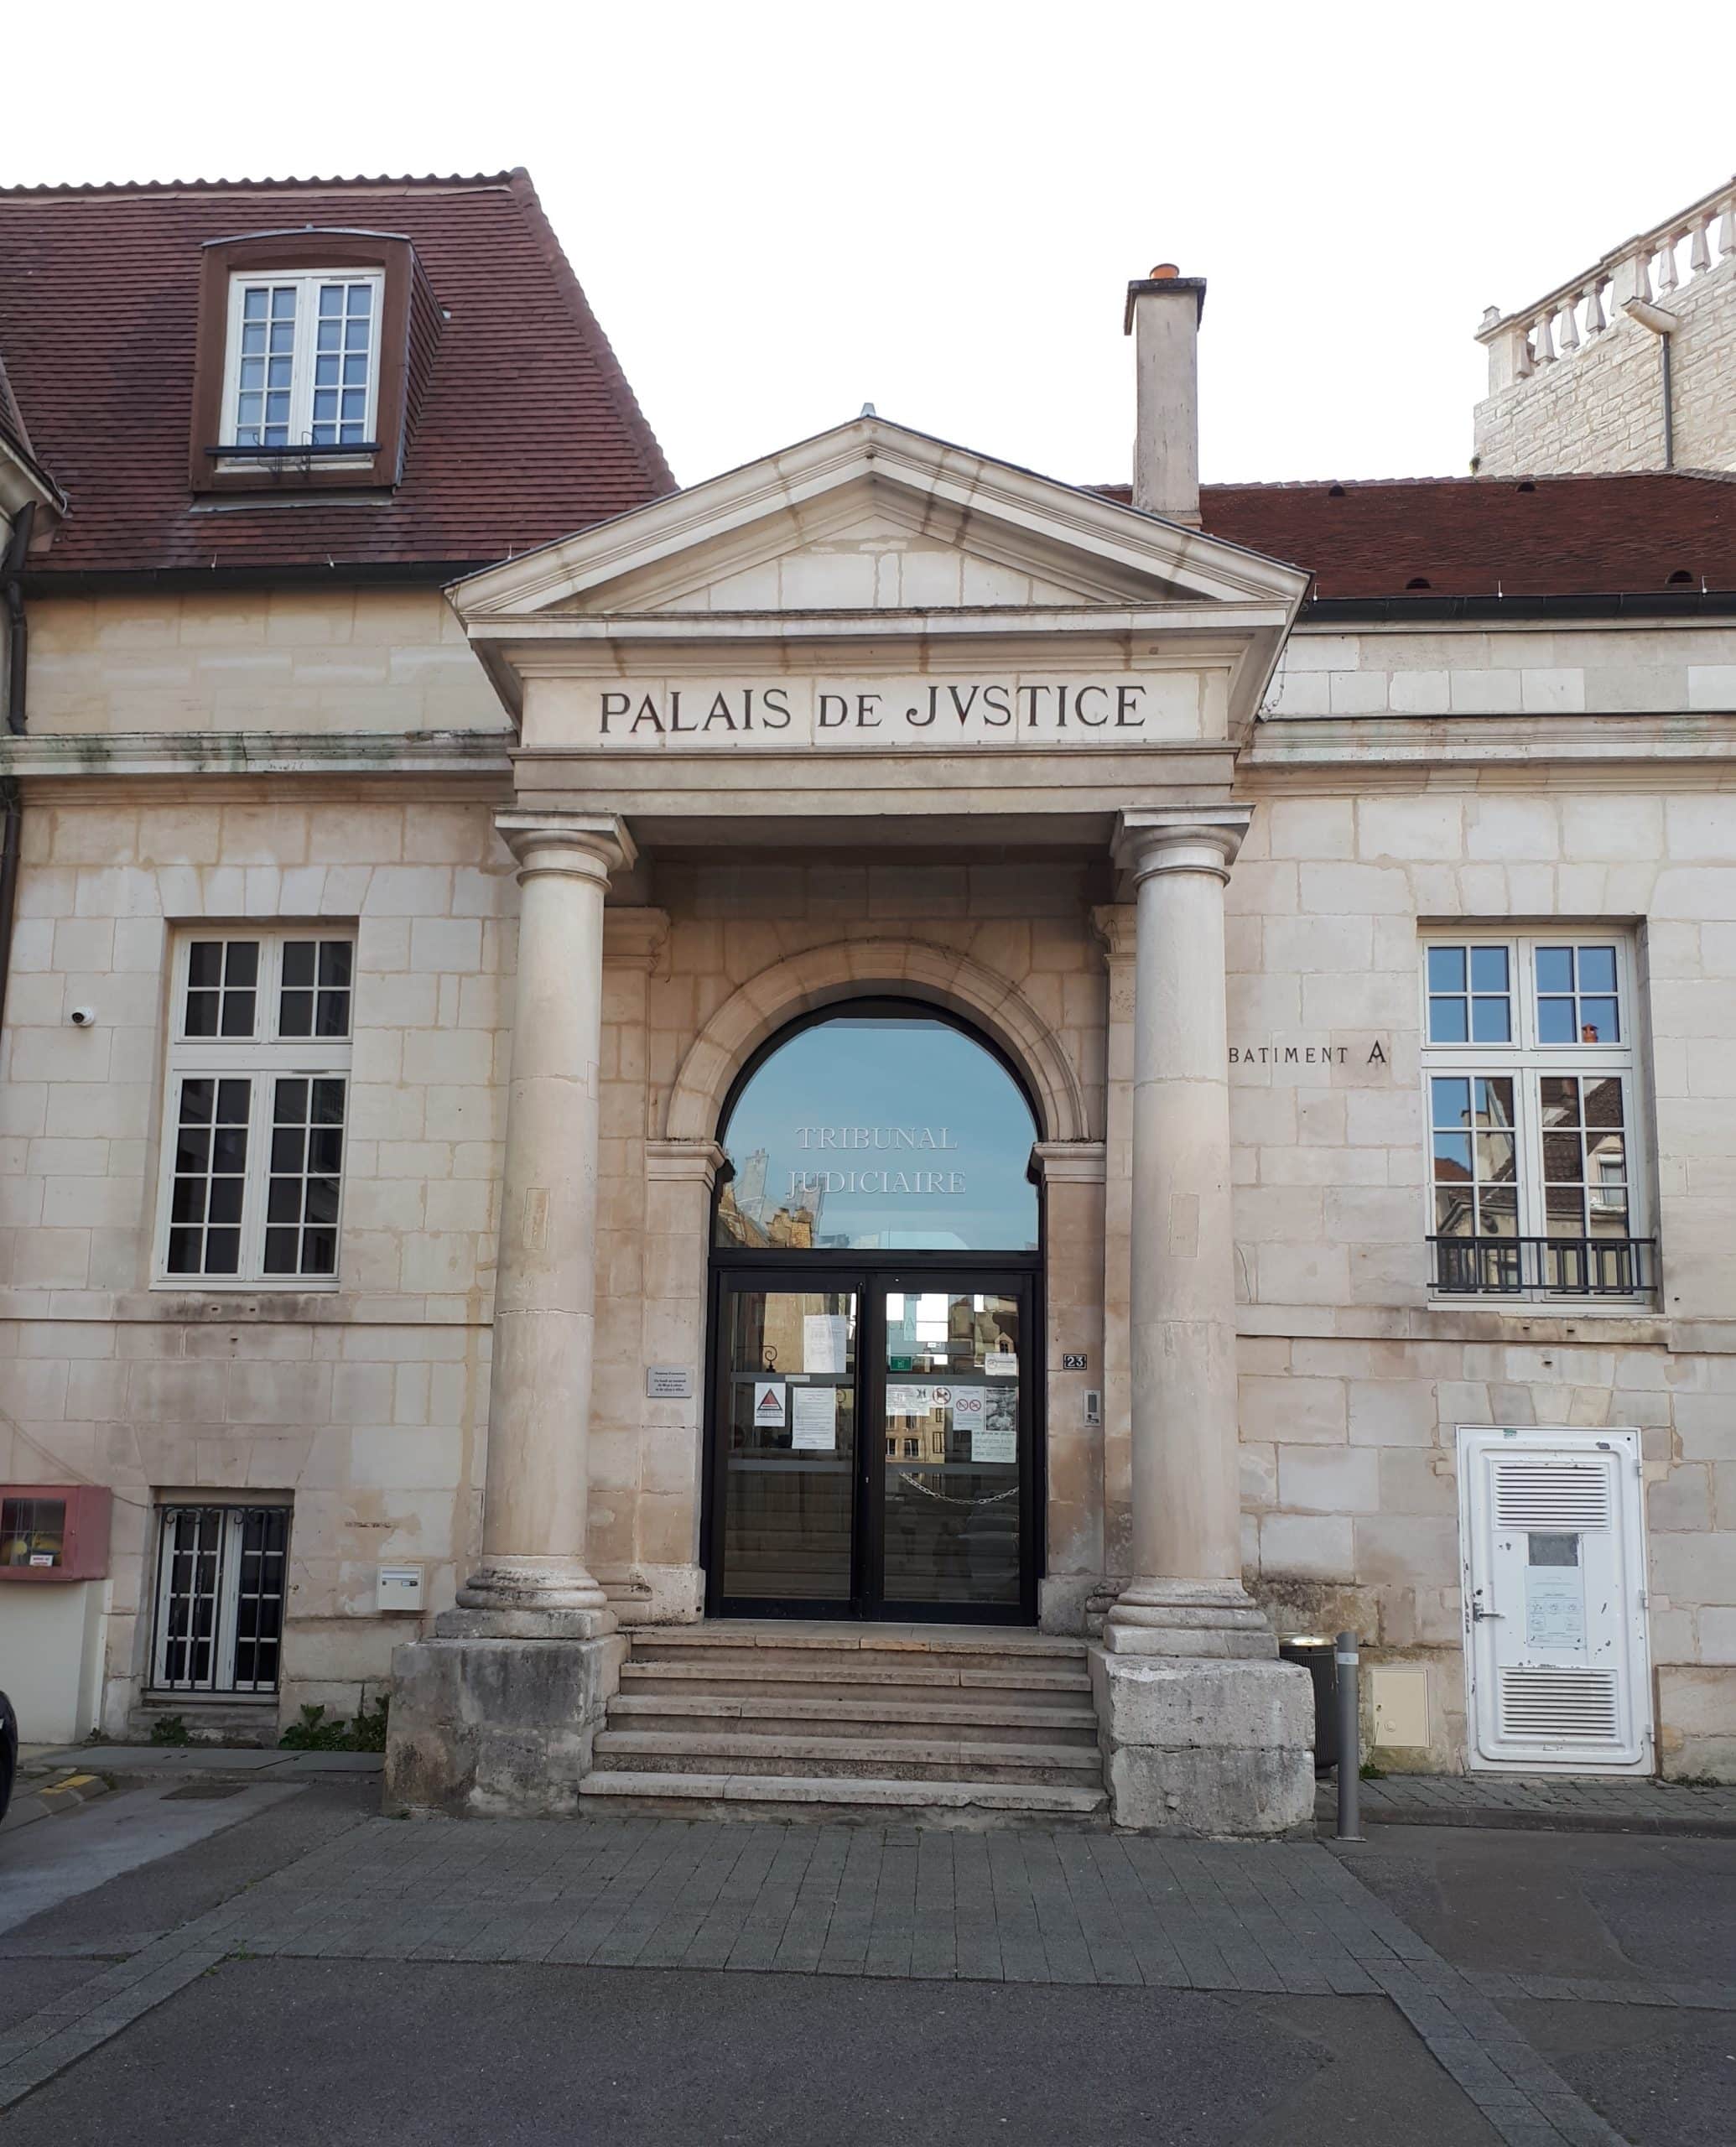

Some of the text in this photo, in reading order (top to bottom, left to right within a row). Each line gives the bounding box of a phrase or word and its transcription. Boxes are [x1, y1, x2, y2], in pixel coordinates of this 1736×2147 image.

[599, 684, 1147, 734] PALAIS DE JVSTICE
[1228, 1039, 1387, 1063] BATIMENT A
[795, 1127, 958, 1150] TRIBUNAL
[786, 1171, 966, 1200] JUDICIAIRE
[1068, 1356, 1084, 1367] 23
